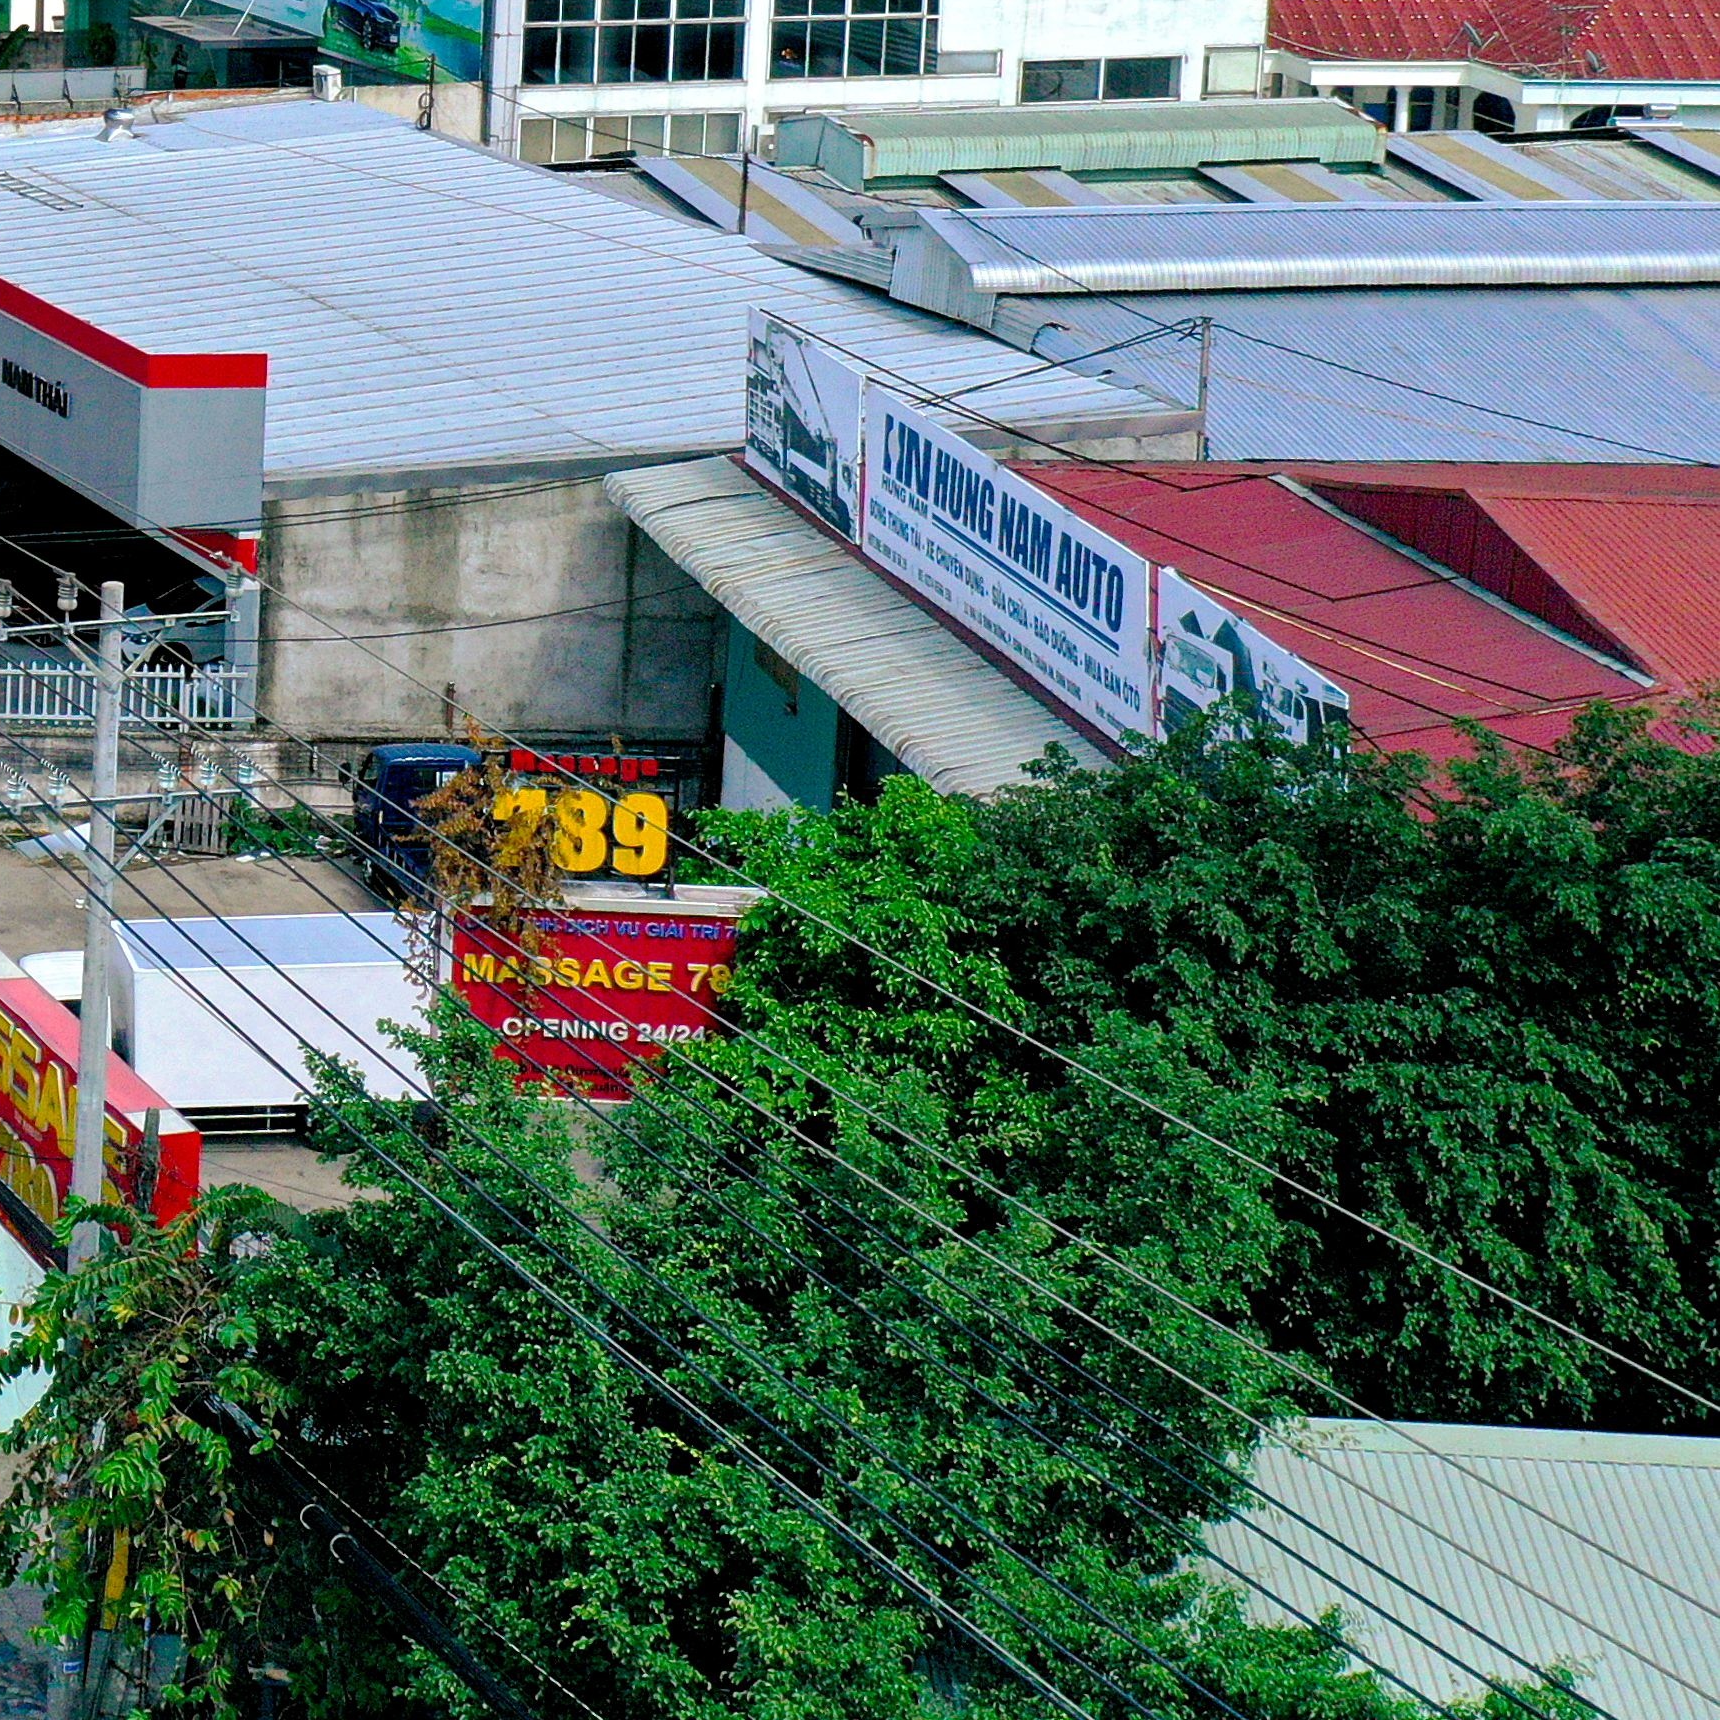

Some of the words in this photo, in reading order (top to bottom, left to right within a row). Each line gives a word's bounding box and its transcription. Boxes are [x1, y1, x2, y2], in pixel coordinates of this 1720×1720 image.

[2, 358, 33, 399] NAM
[998, 491, 1053, 584] NAM
[1054, 530, 1125, 633] AUTO
[644, 918, 685, 939] GIẢI
[463, 953, 673, 993] MASSAGE
[687, 963, 732, 994] 78
[502, 1016, 629, 1043] OPENING
[636, 1023, 706, 1044] 24/24
